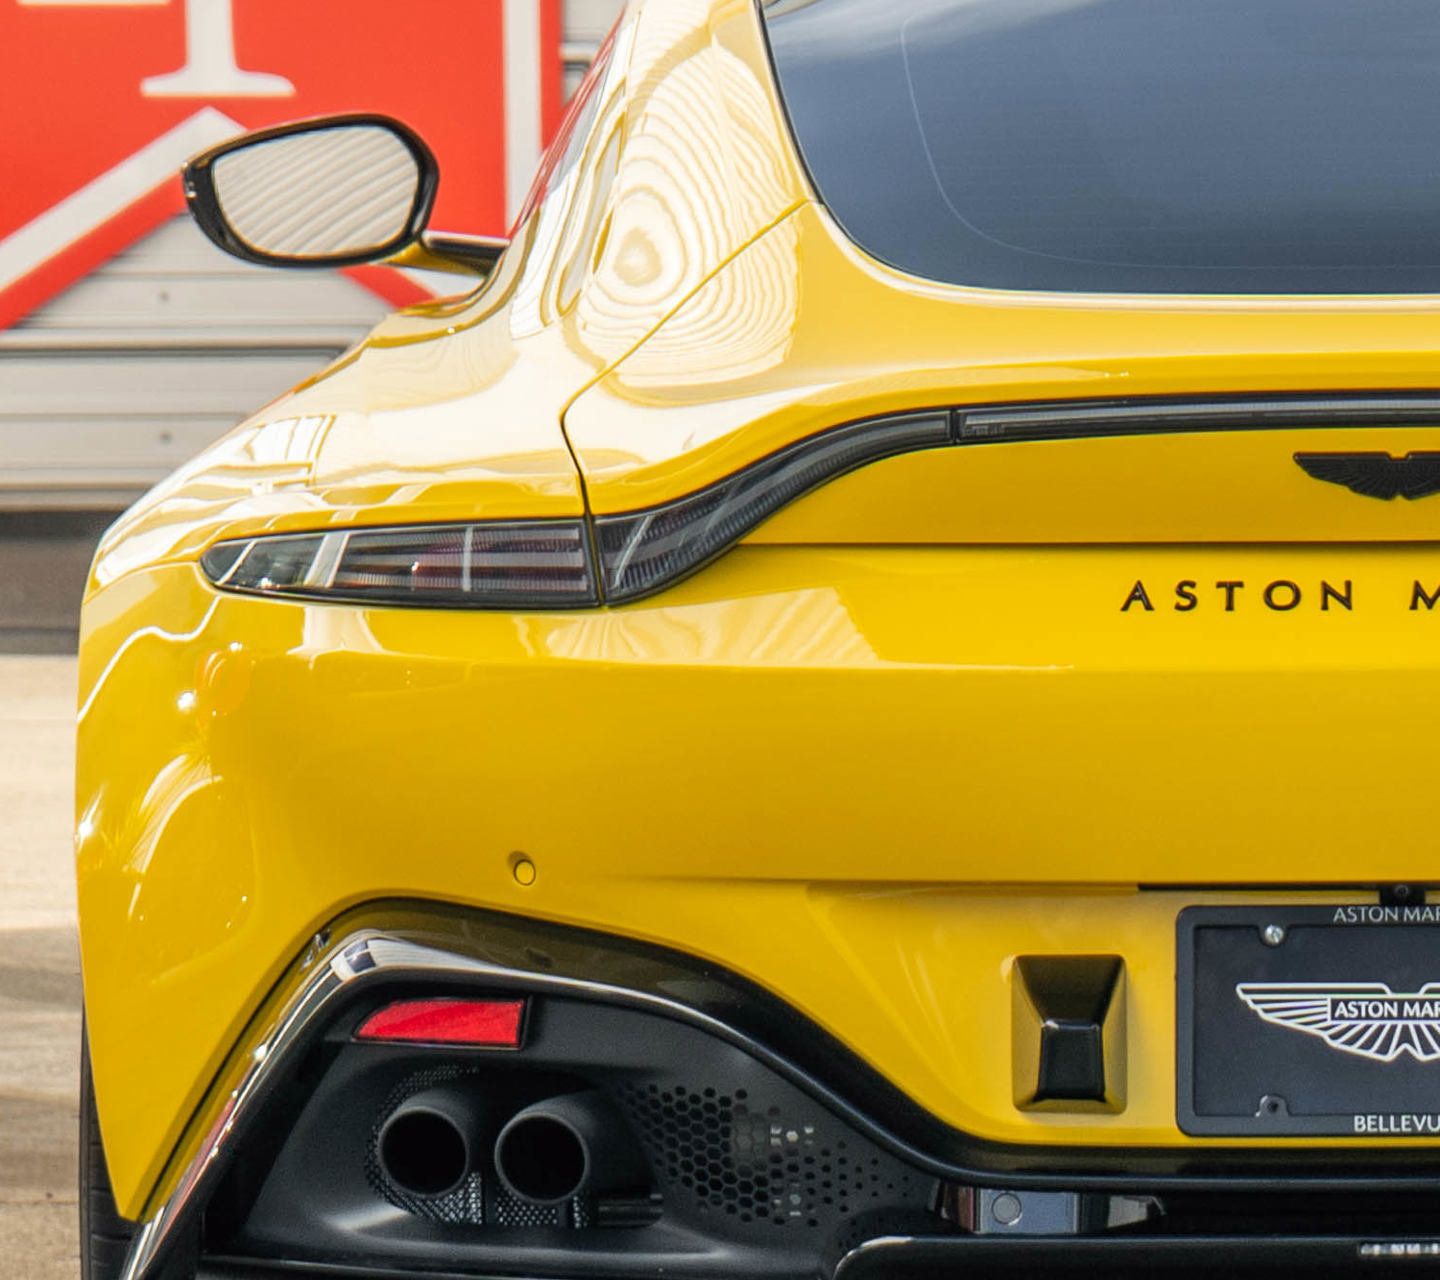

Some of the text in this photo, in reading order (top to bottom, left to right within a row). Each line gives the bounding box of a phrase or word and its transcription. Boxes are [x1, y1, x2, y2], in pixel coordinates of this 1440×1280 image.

[1119, 579, 1353, 612] ASTON
[1333, 905, 1399, 923] ASTON
[1334, 1000, 1398, 1018] ASTON
